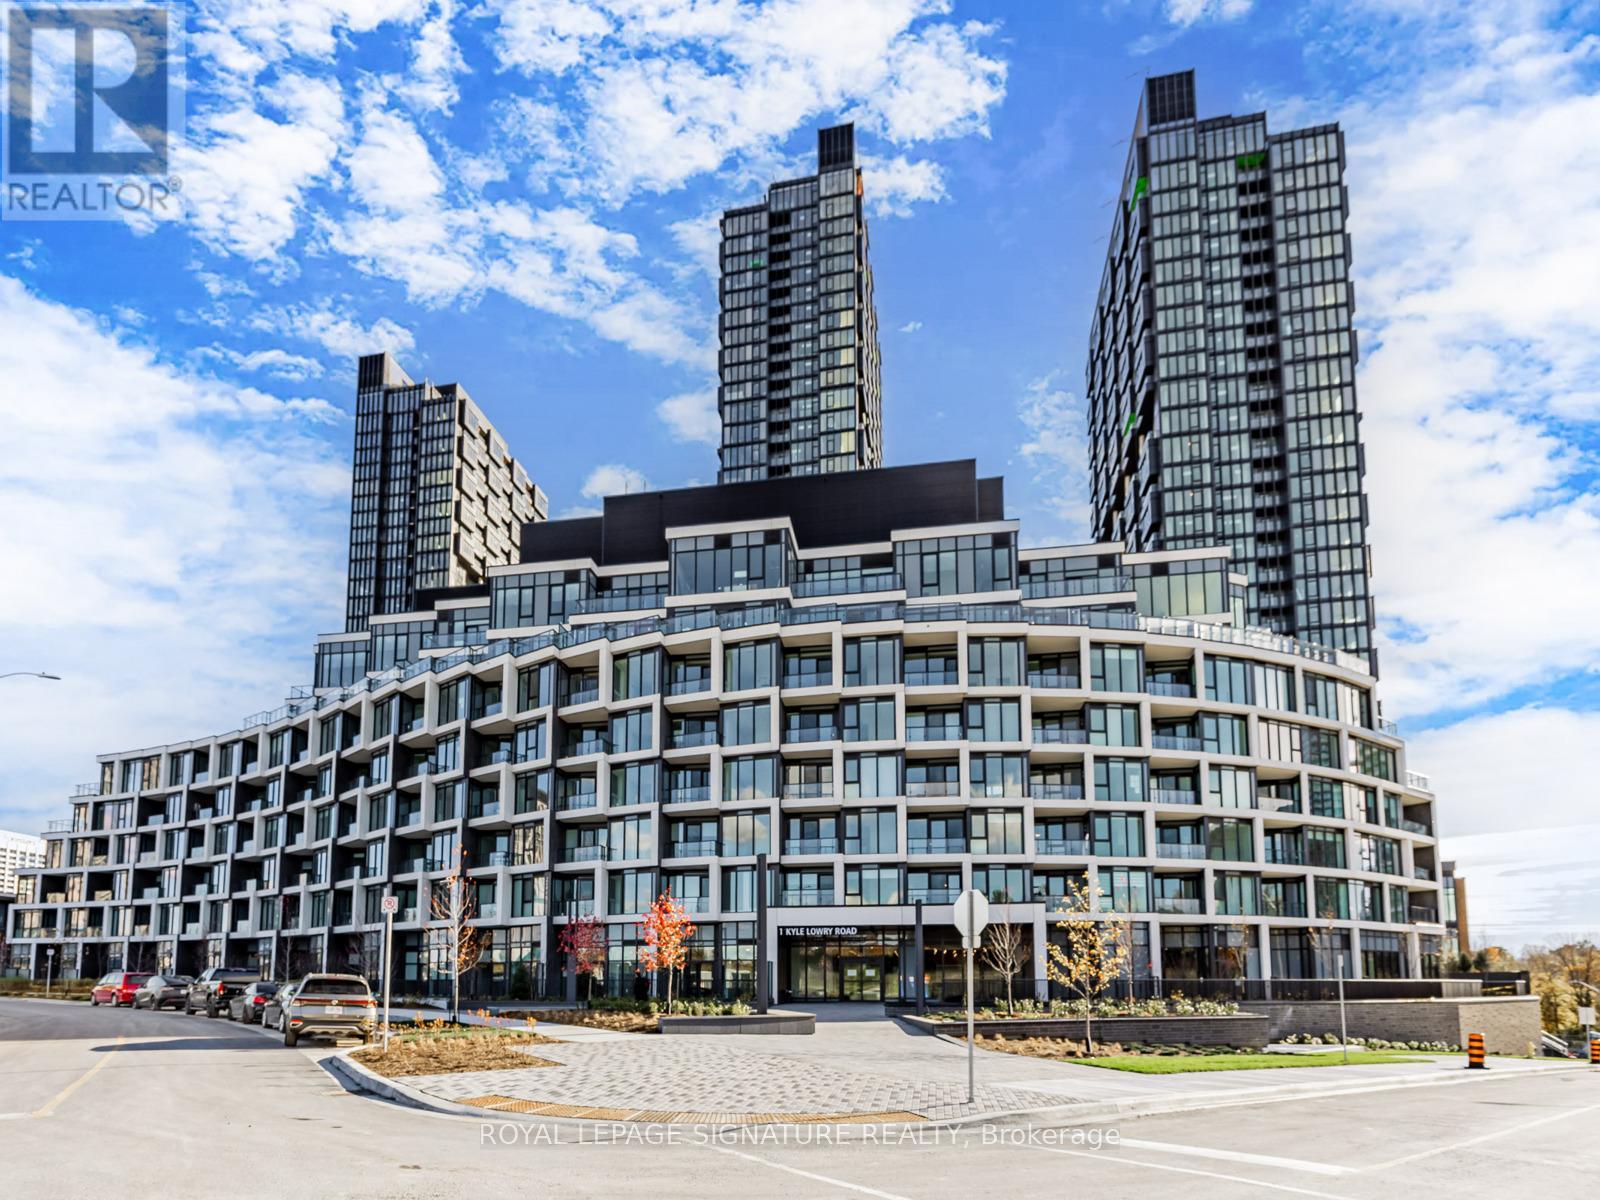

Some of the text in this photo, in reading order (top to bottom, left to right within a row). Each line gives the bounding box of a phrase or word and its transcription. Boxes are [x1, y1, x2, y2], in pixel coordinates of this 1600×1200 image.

[785, 927, 805, 936] KYLE
[806, 927, 833, 936] LOWRY
[834, 926, 858, 936] ROAD
